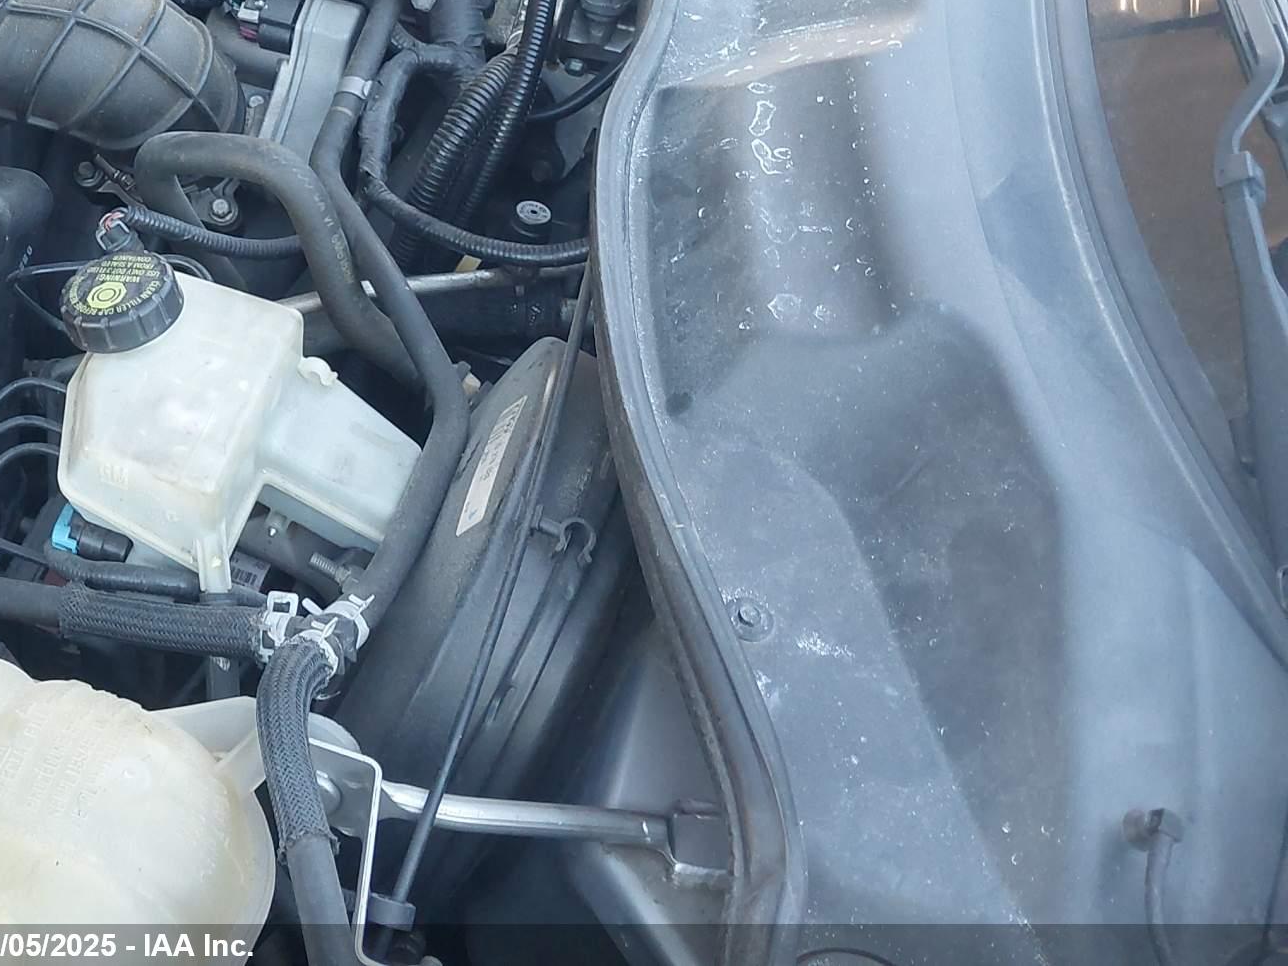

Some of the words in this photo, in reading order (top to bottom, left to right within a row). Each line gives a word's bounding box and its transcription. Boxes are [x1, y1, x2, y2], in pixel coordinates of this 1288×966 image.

[95, 273, 141, 283] WARNING!
[115, 296, 141, 313] FILLER
[97, 307, 114, 316] CAP
